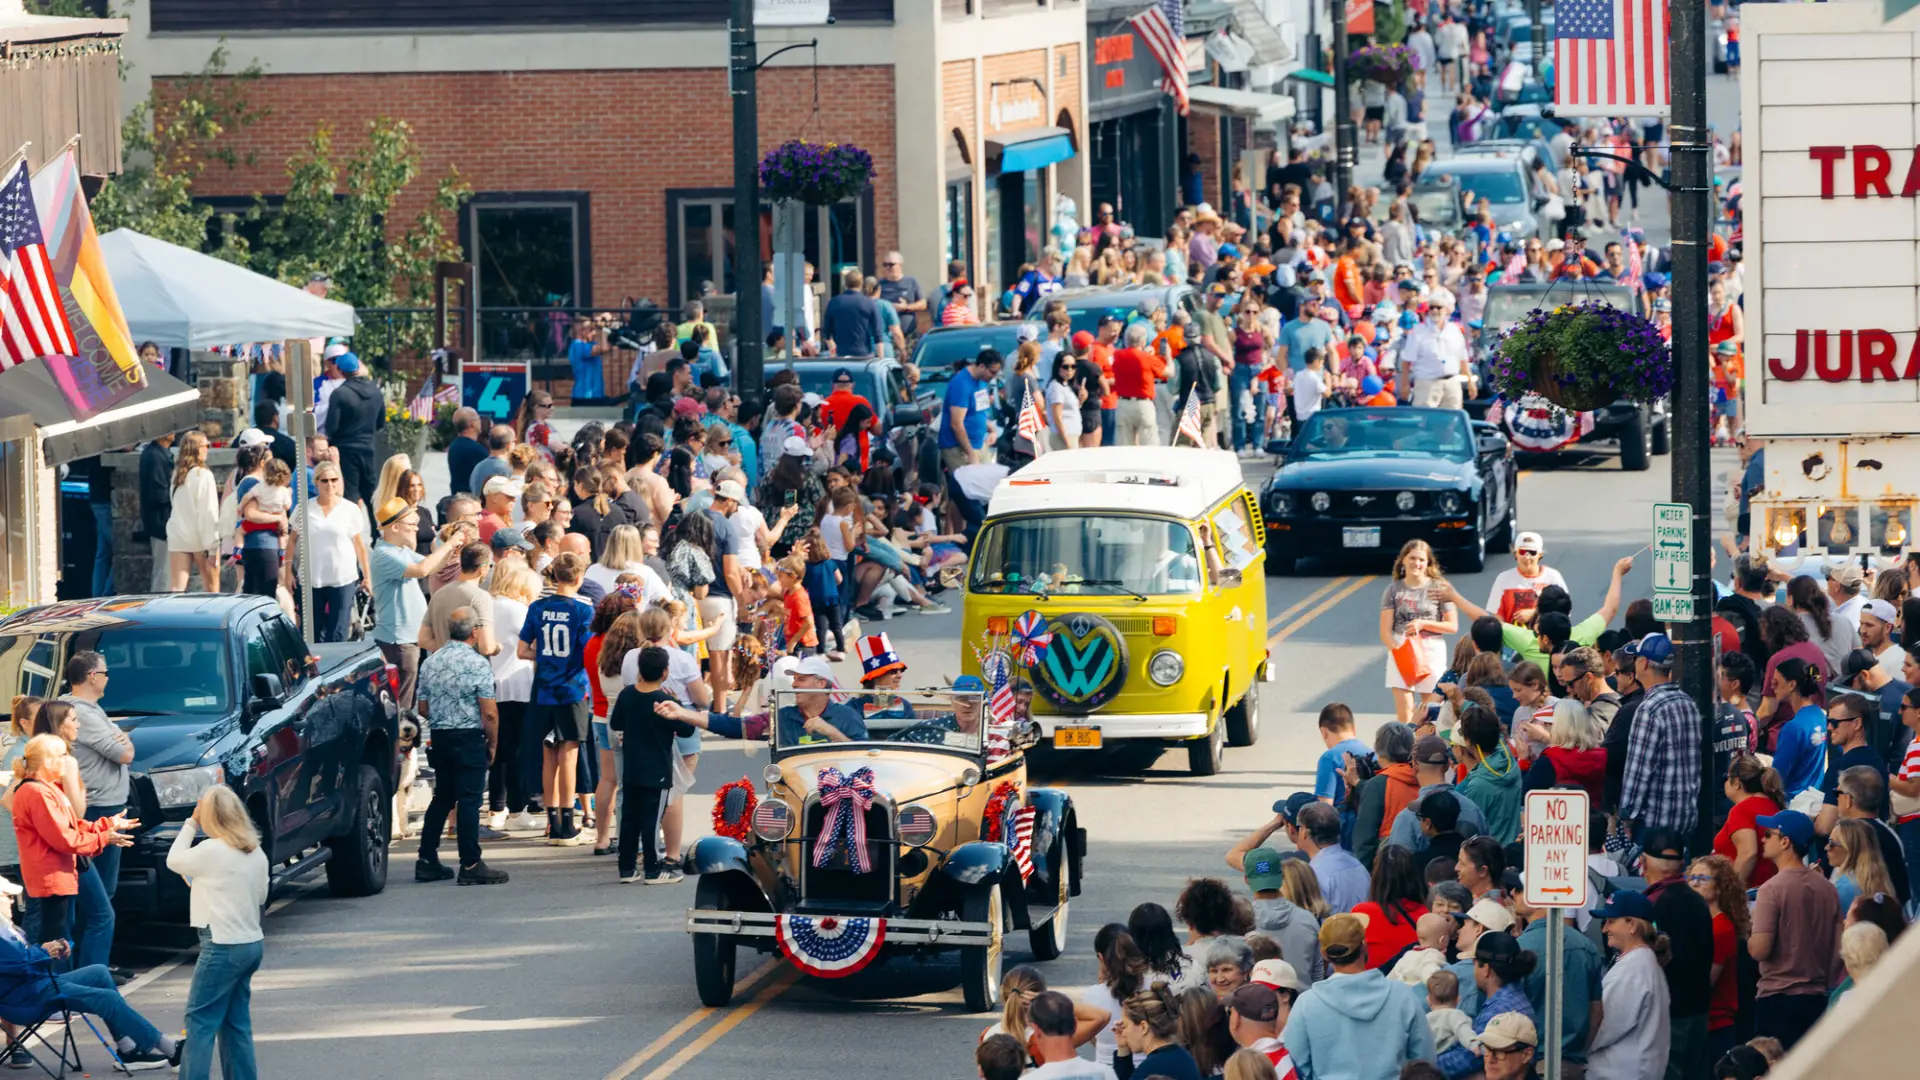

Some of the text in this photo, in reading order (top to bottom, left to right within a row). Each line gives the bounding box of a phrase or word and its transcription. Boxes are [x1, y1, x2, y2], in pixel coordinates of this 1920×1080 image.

[477, 376, 511, 418] 4
[1660, 510, 1683, 520] METER
[1657, 526, 1687, 538] PARKING
[1655, 549, 1689, 562] PAY HERE
[1654, 598, 1692, 615] 8AM-8PM
[541, 623, 570, 657] 10
[1077, 731, 1091, 743] BUS
[1546, 799, 1567, 820] NO
[1531, 824, 1582, 845] PARKING
[1546, 849, 1567, 862] ANY
[1543, 866, 1569, 880] TIME
